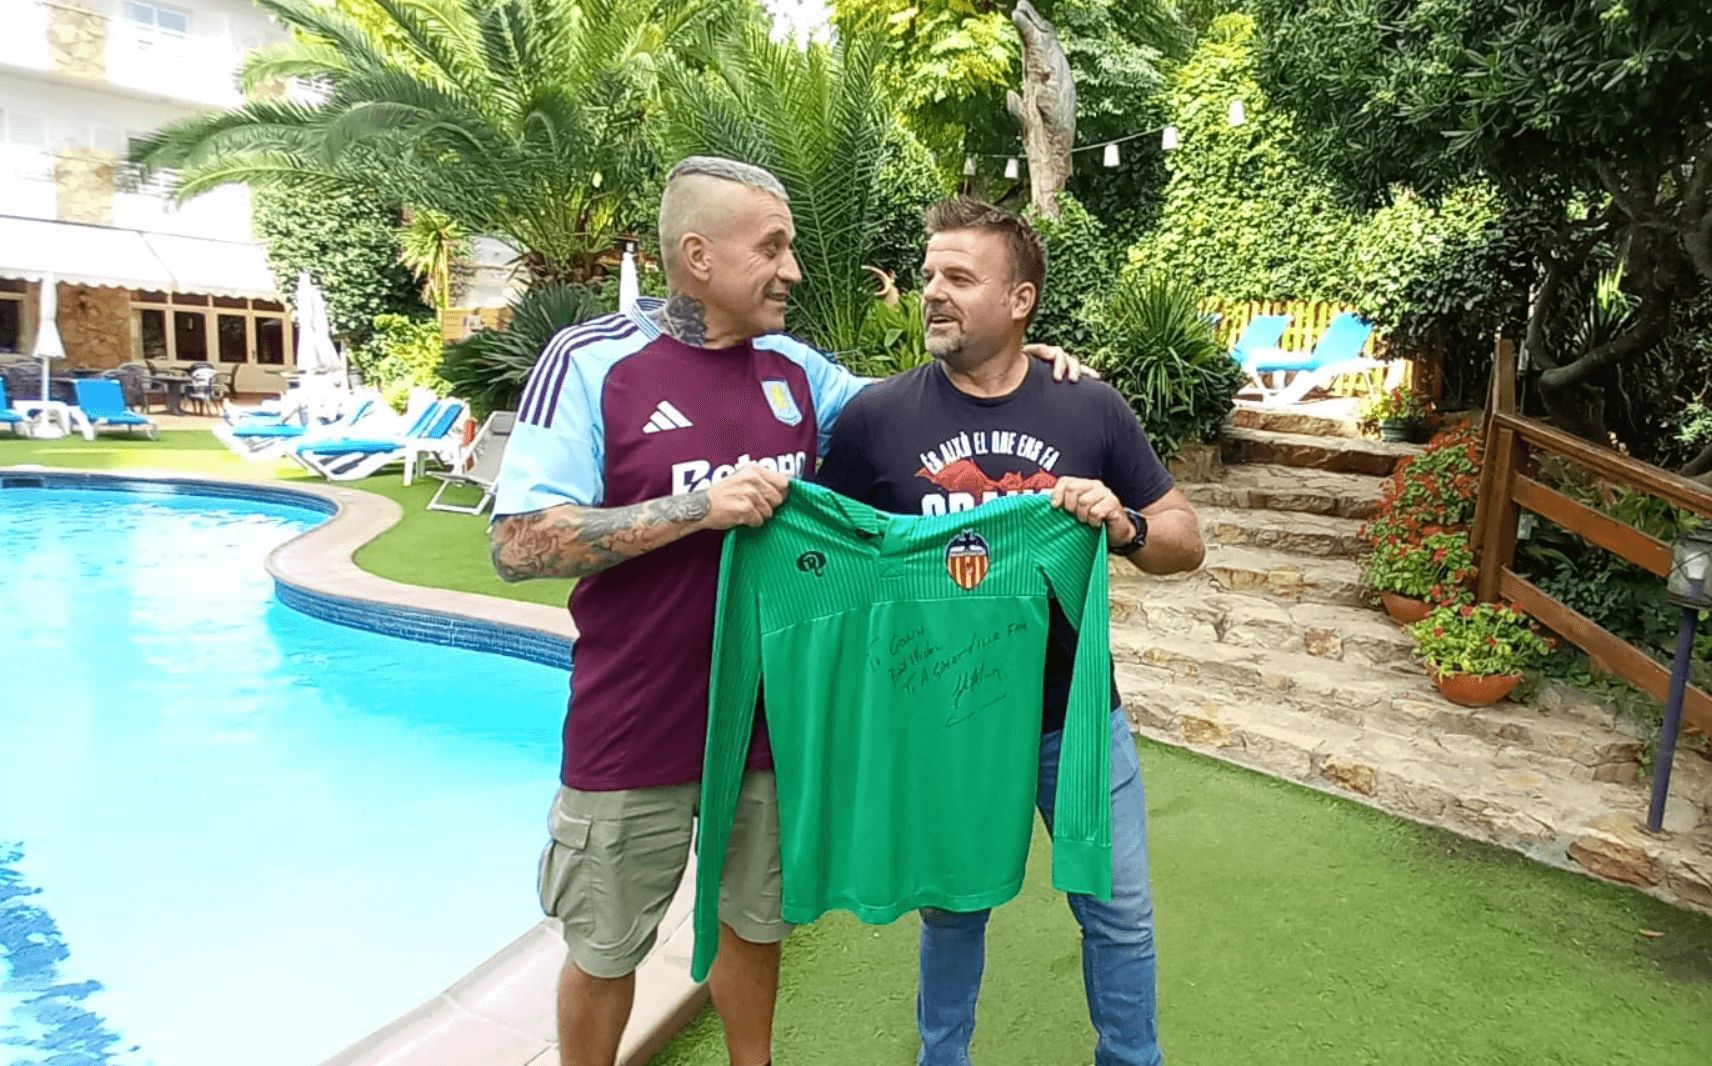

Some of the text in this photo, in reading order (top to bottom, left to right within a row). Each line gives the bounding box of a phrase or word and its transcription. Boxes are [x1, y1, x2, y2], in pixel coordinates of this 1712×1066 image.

[973, 431, 988, 455] EL
[991, 430, 1017, 454] QUE
[1016, 434, 1044, 463] ENS
[1038, 446, 1060, 472] FA
